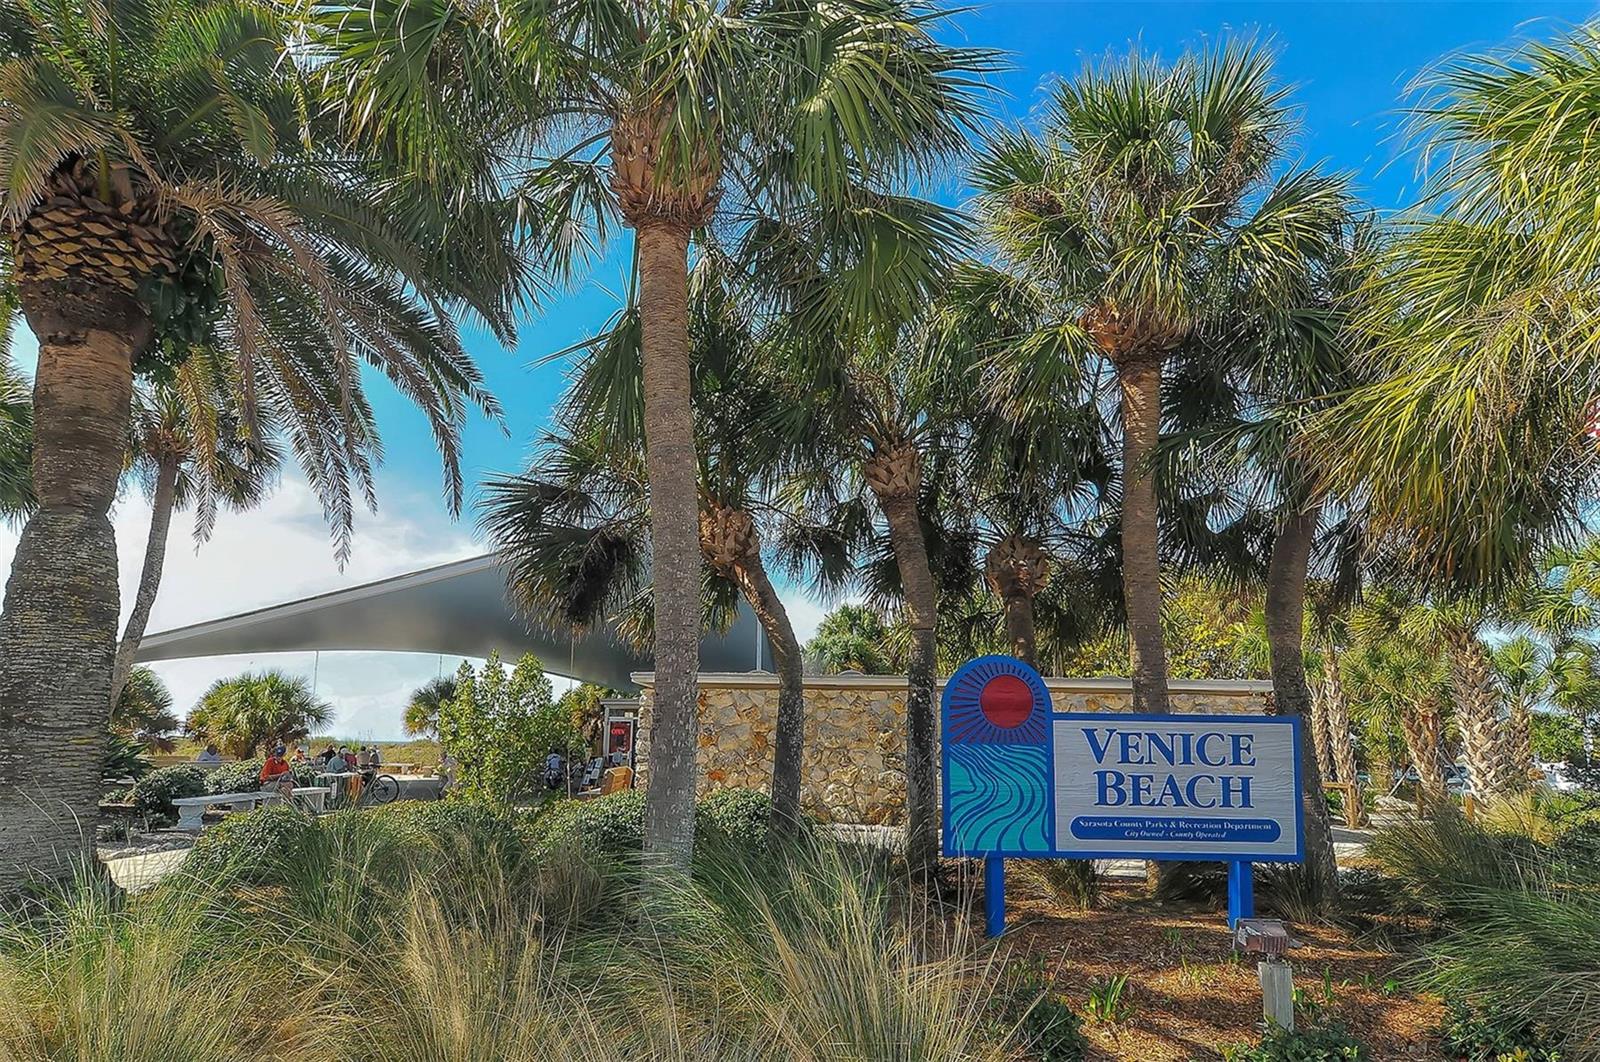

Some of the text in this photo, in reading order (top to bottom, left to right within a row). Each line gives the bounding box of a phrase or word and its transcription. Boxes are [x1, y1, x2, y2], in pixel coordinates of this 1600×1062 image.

[1081, 728, 1257, 767] VENICE
[1093, 770, 1255, 809] BEACH
[1114, 820, 1143, 828] County
[1145, 820, 1168, 828] Parks
[1178, 821, 1221, 829] Recreation
[1223, 822, 1272, 830] Department
[1124, 830, 1139, 838] City
[1170, 831, 1193, 839] County
[1195, 831, 1227, 839] Operated
